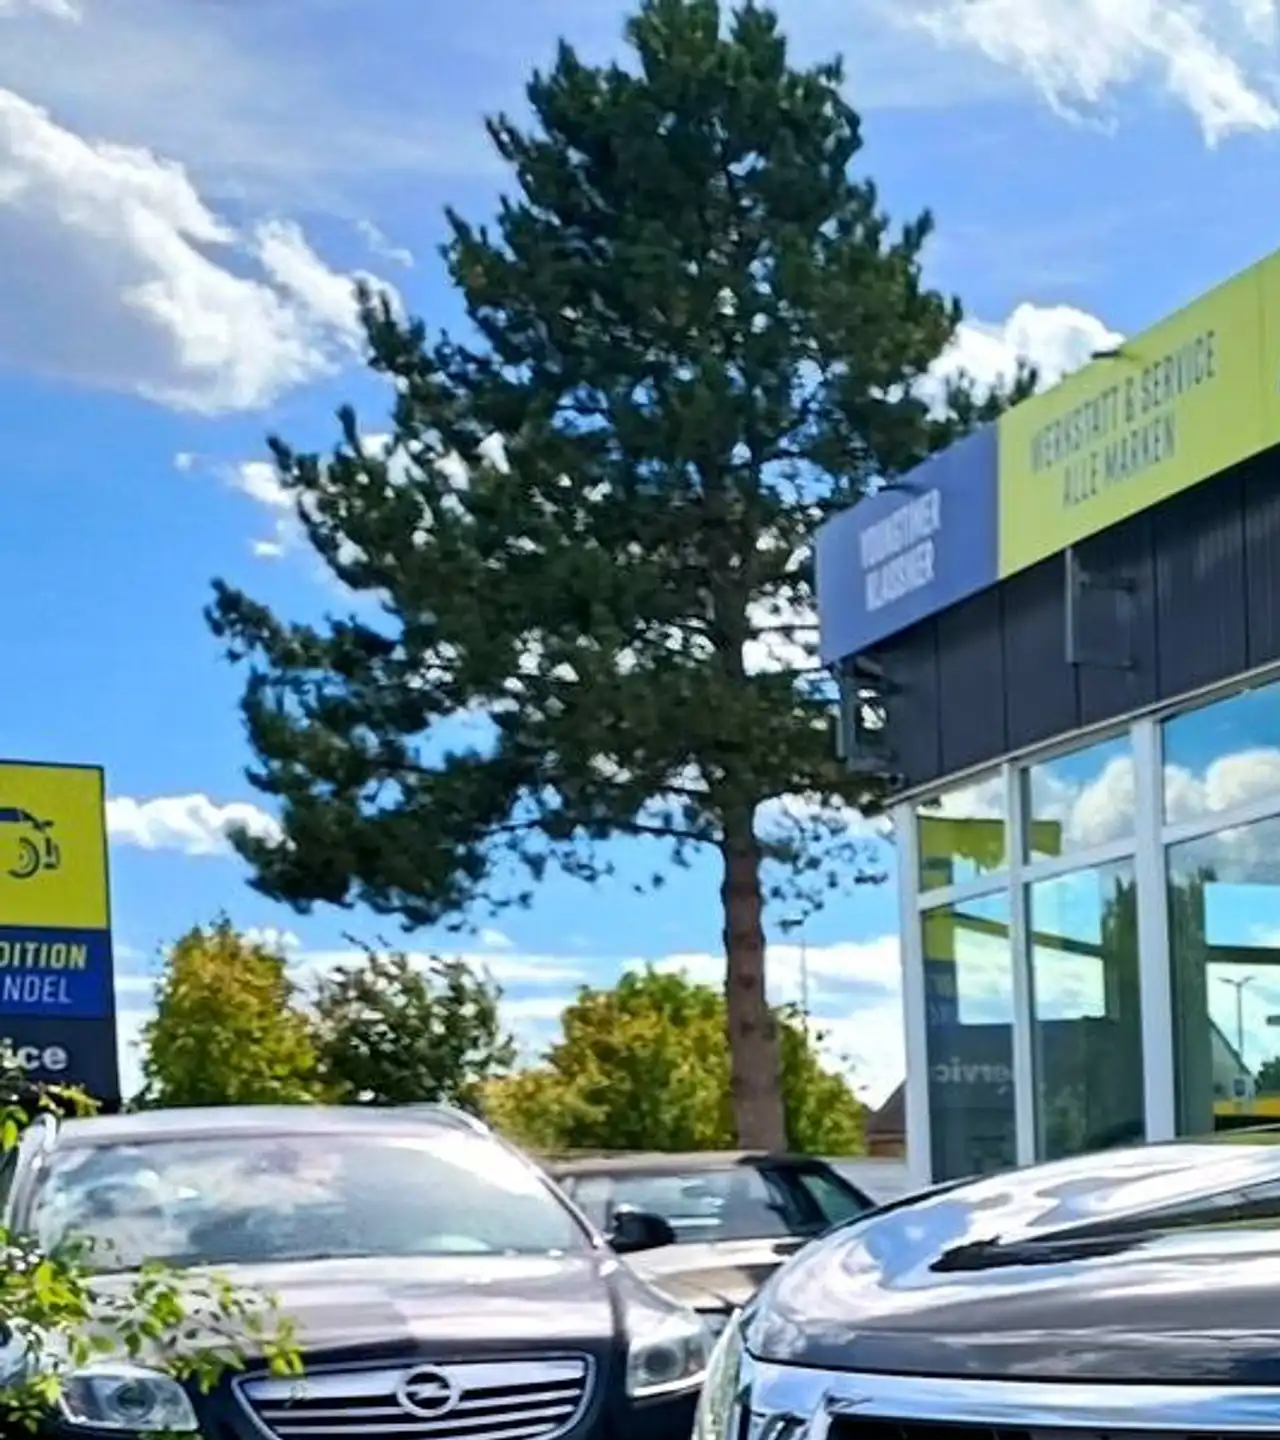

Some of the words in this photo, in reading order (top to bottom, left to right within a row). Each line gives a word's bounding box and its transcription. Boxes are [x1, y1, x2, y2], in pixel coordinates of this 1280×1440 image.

[1030, 384, 1119, 475] WERKSTATT
[1140, 329, 1216, 414] SERVICE
[1062, 450, 1099, 509] ALLE
[1103, 411, 1177, 486] MARKEN
